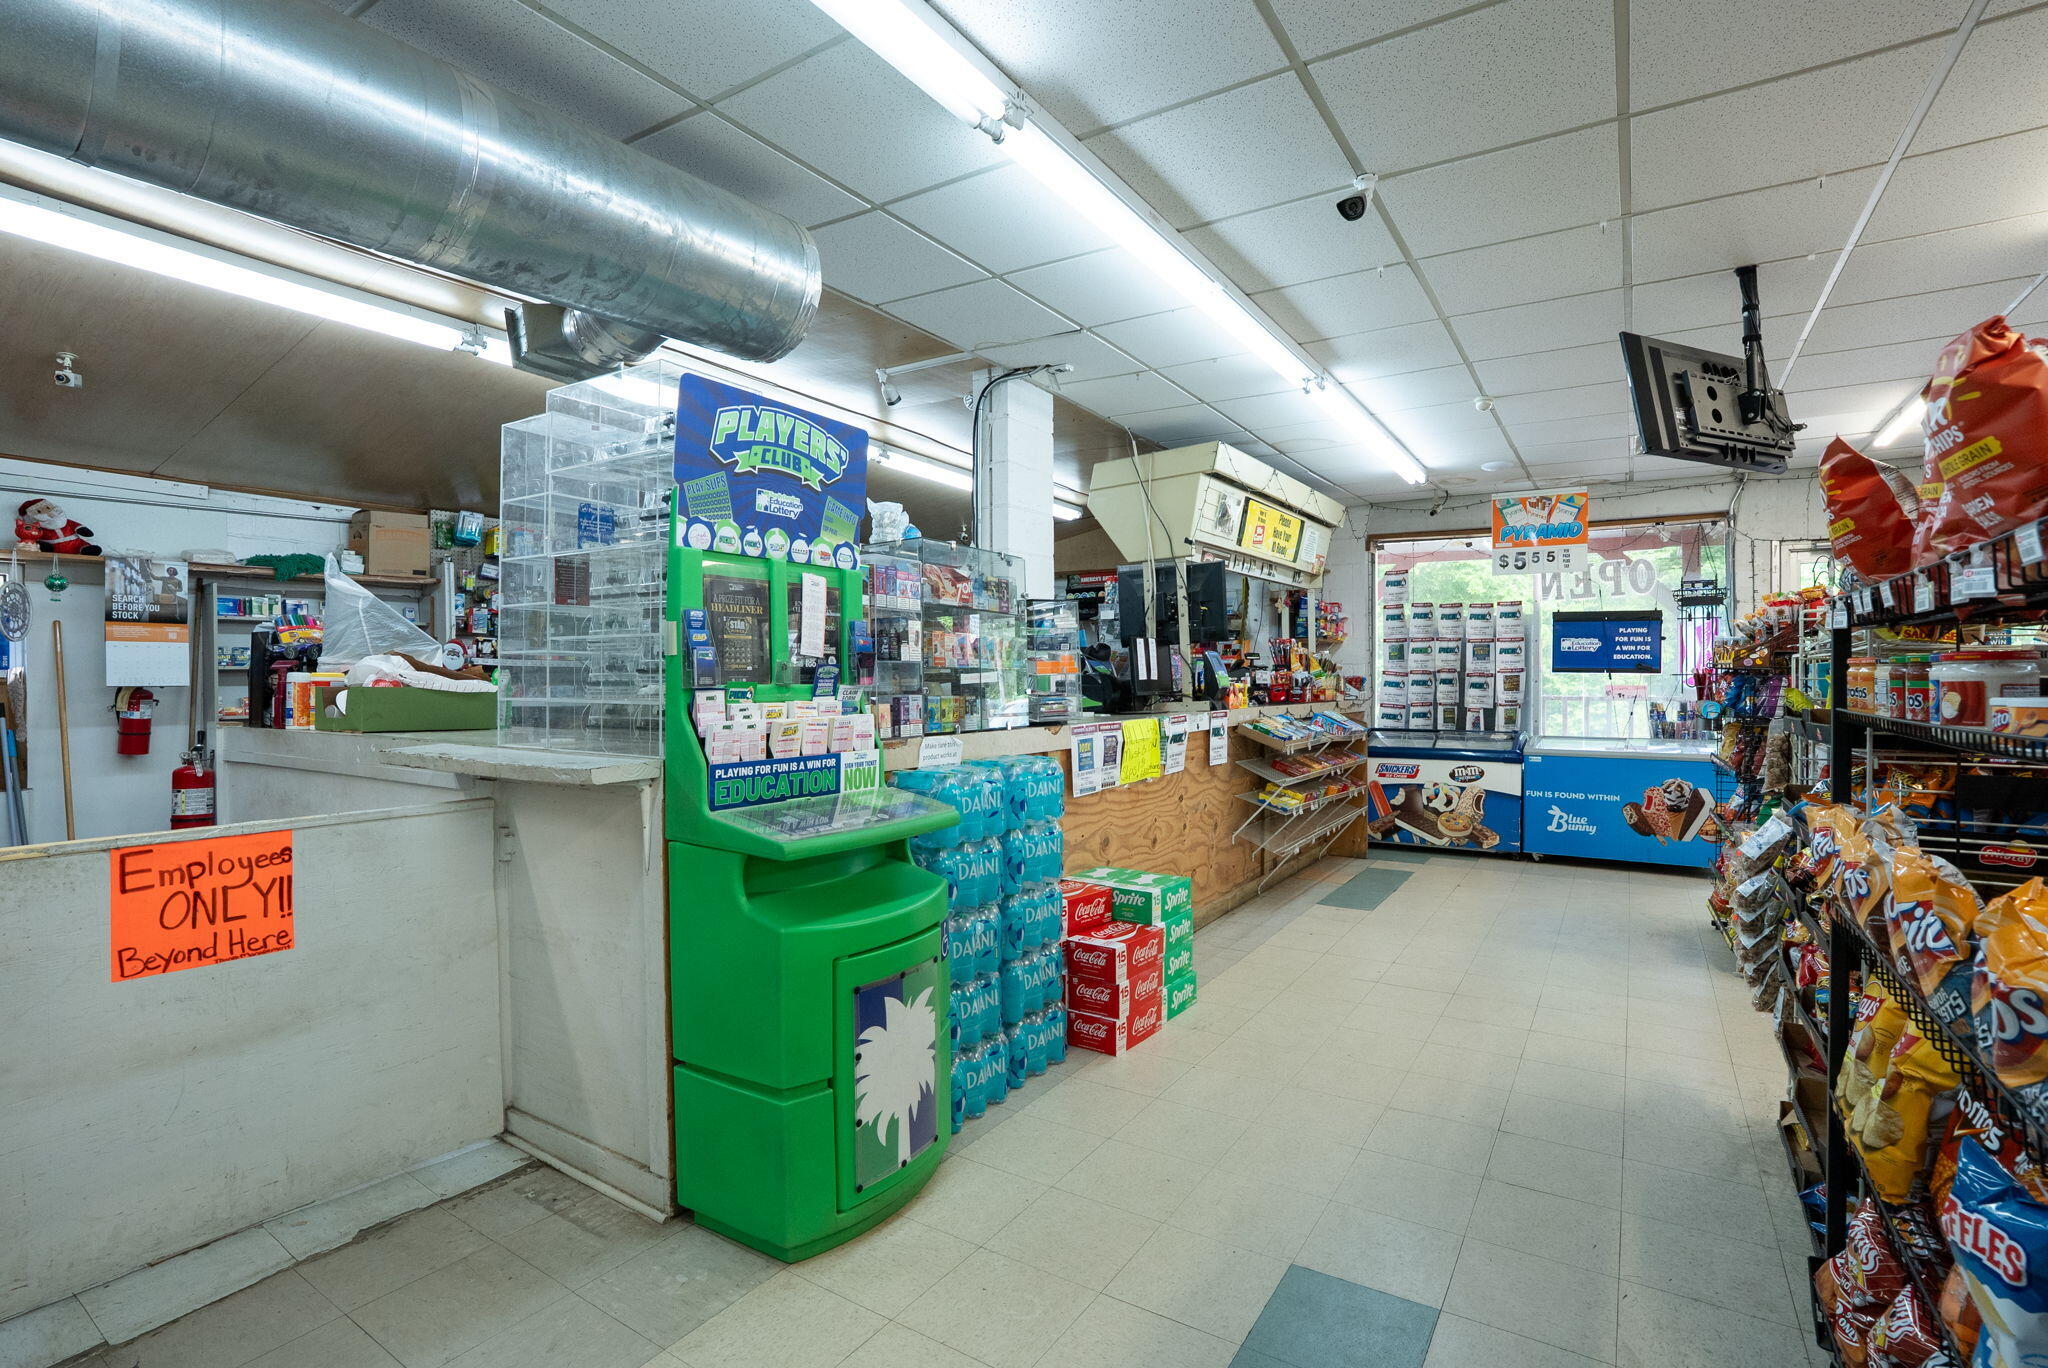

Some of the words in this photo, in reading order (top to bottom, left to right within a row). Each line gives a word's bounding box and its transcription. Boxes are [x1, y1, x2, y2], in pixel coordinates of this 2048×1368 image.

[760, 448, 802, 472] CLUB
[1959, 443, 1993, 466] GRAIN
[687, 481, 704, 494] PLAY
[704, 475, 726, 491] SLIPS
[770, 497, 803, 509] Education
[770, 503, 799, 519] Lottery
[827, 500, 843, 518] GAME
[843, 511, 857, 526] INFO
[1279, 513, 1292, 528] Please
[1501, 522, 1583, 541] PYRAMID
[112, 594, 144, 603] SEARCH
[112, 602, 144, 611] BEFORE
[144, 604, 160, 612] YOU
[112, 611, 139, 619] STOCK
[711, 603, 763, 615] HEADLINER
[729, 620, 746, 630] STAR
[715, 766, 754, 779] PLAYING
[755, 764, 771, 775] FOR
[773, 762, 789, 773] FUN
[790, 761, 798, 771] IS
[799, 761, 805, 770] A
[806, 760, 821, 769] WIN
[822, 758, 836, 767] FOR
[845, 761, 853, 769] SIGN
[854, 760, 864, 768] YOUR
[864, 759, 877, 767] TICKET
[1379, 763, 1416, 774] SNICKERS
[714, 768, 836, 806] EDUCATION
[844, 767, 877, 791] NOW
[1555, 792, 1585, 800] FOUND
[1587, 793, 1621, 802] WITHIN
[119, 846, 293, 894] Employees
[159, 875, 293, 930] ONLY!!
[1112, 890, 1145, 906] Sprite
[1165, 887, 1190, 912] Sprite
[1075, 897, 1106, 920] Coca-Cola
[1170, 917, 1192, 943] Sprite
[118, 931, 218, 978] Beyond
[229, 928, 292, 955] Here
[1073, 948, 1106, 966] Coca-Cola
[1116, 951, 1126, 963] 15
[1133, 938, 1159, 965] Coca-Cola
[1168, 950, 1191, 976] Sprite
[1076, 984, 1112, 1002] Coca-Cola
[1119, 986, 1129, 999] 15
[1135, 971, 1159, 999] Coca-Cola
[1172, 983, 1195, 1010] Sprite
[1859, 997, 1880, 1022] ay's
[1073, 1019, 1107, 1039] Coca-Cola
[1116, 1022, 1126, 1035] 15
[1132, 1006, 1158, 1035] Coca-Cola
[1838, 1317, 1858, 1342] ONLY
